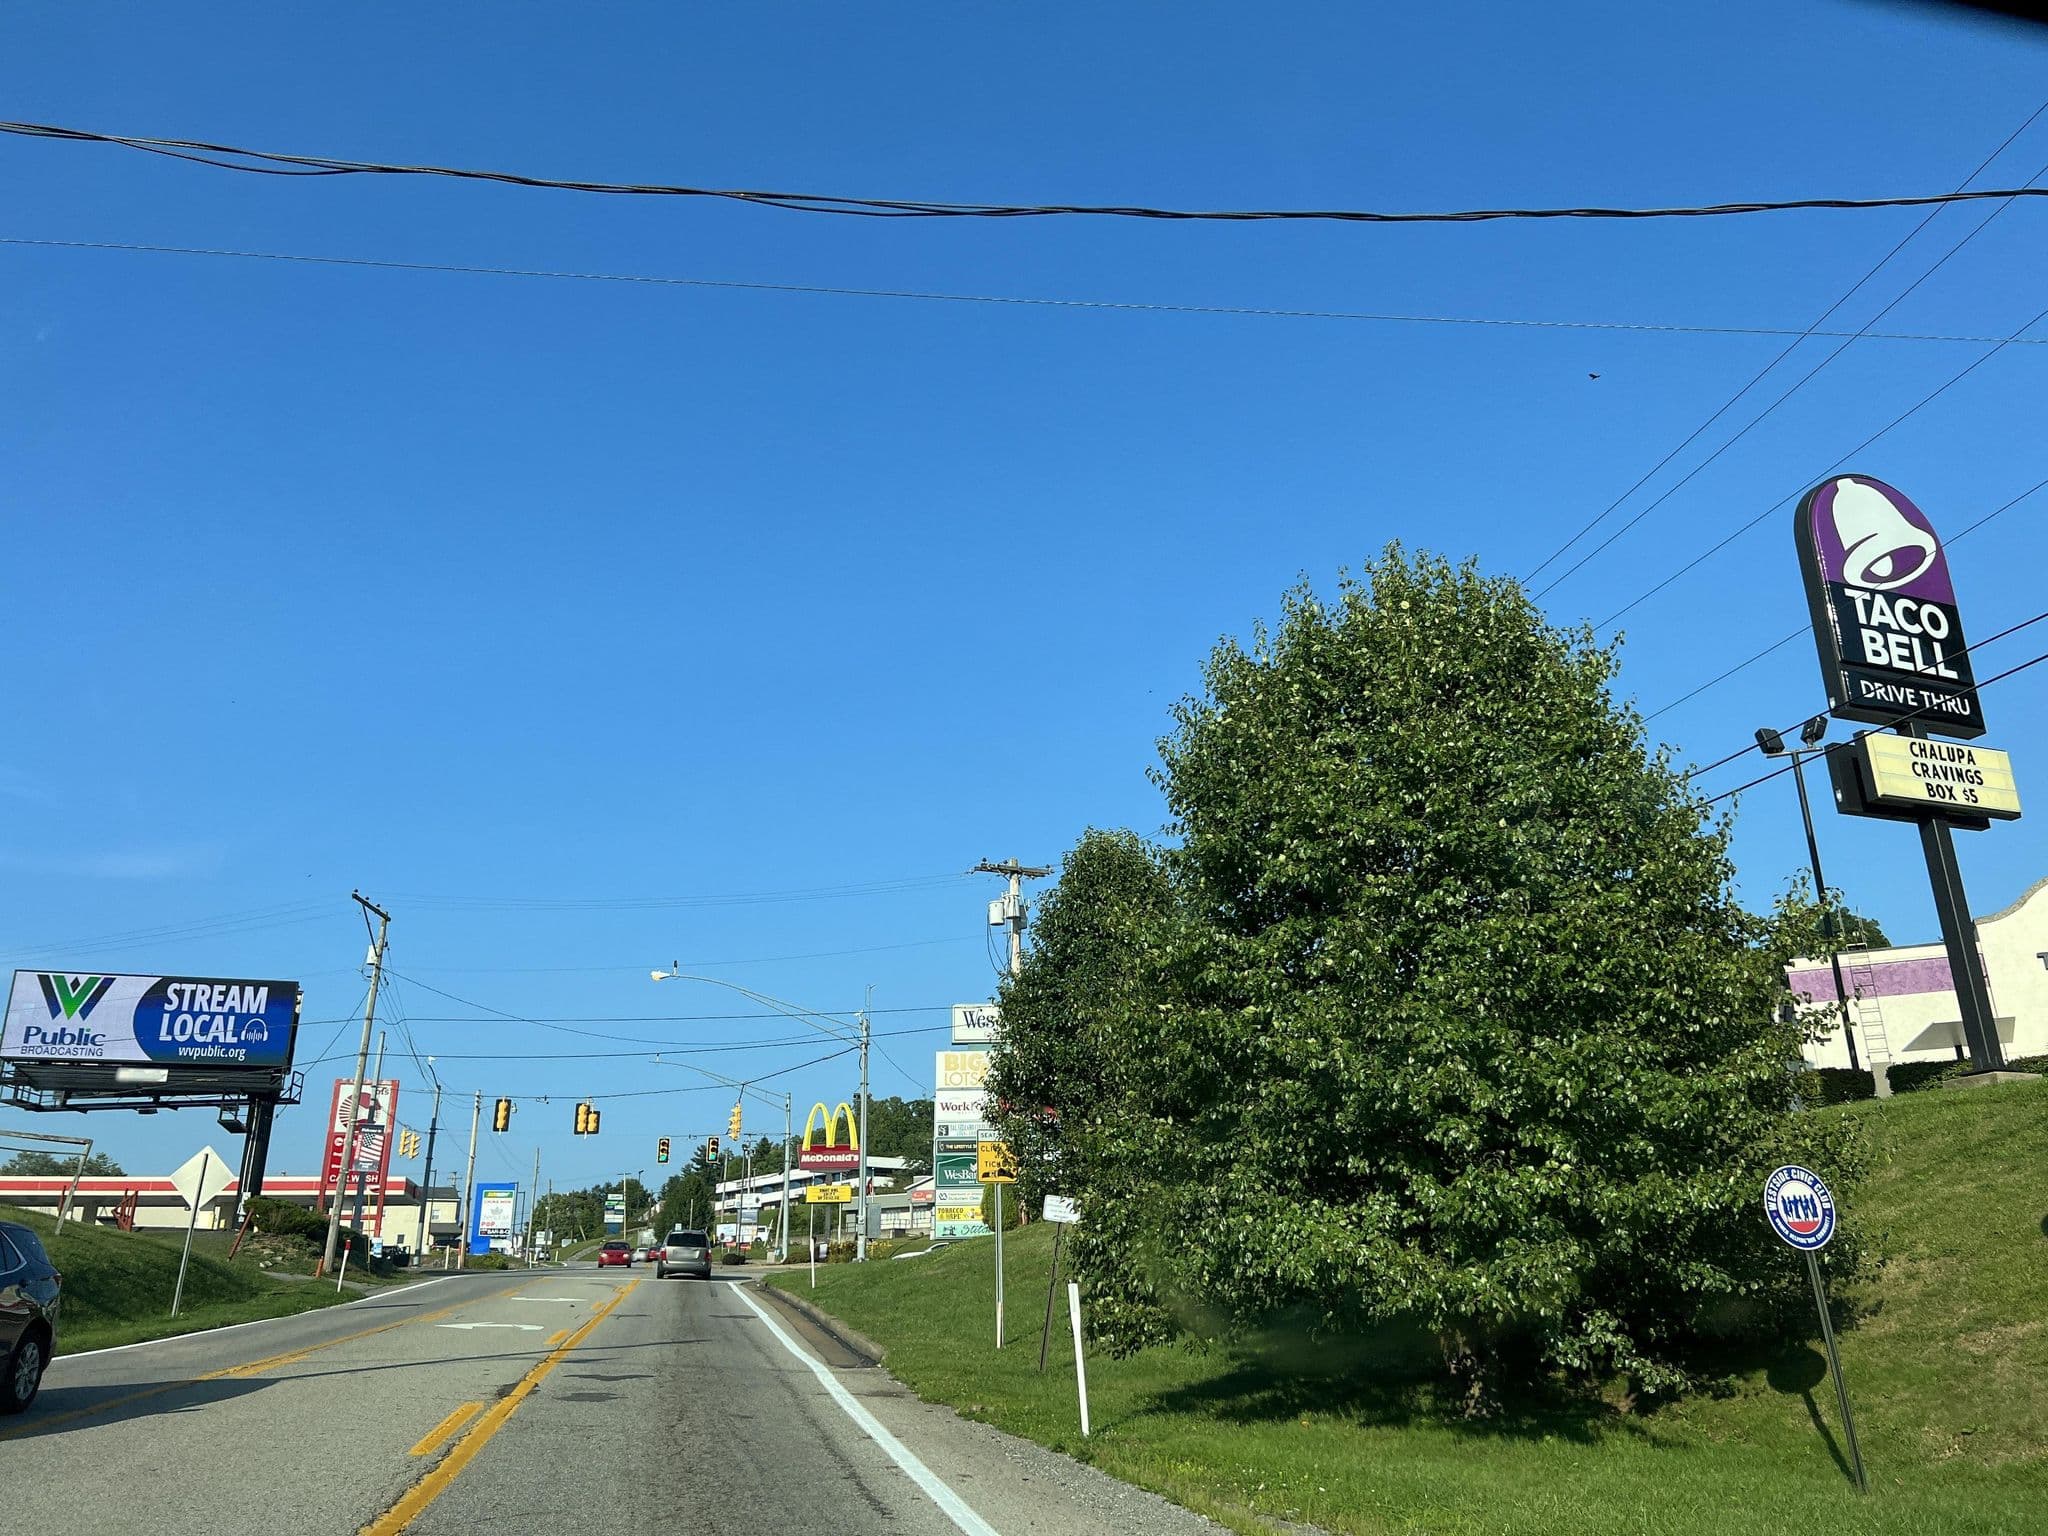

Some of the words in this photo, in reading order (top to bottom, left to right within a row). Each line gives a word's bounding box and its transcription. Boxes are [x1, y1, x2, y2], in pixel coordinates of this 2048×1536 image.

[1844, 587, 1949, 640] TACO
[1861, 628, 1959, 680] BELL
[1859, 678, 1918, 707] DRIVE
[1919, 690, 1971, 717] THRU
[1909, 741, 1977, 766] CHALUPA
[1910, 760, 1984, 786] CRAVINGS
[1926, 782, 1957, 801] BOX
[1963, 788, 1979, 804] $5
[164, 982, 269, 1015] STREAM
[23, 1025, 107, 1047] Public
[159, 1013, 239, 1044] LOCAL
[20, 1045, 104, 1057] BROADCASTING
[178, 1045, 247, 1061] wvpublic.org
[944, 1053, 983, 1071] BIG
[801, 1154, 859, 1163] McDonald's
[351, 1174, 379, 1183] WSH
[1767, 1169, 1790, 1211] WESTSIDE
[1790, 1168, 1815, 1185] CIVIC
[1813, 1183, 1831, 1209] CLUB
